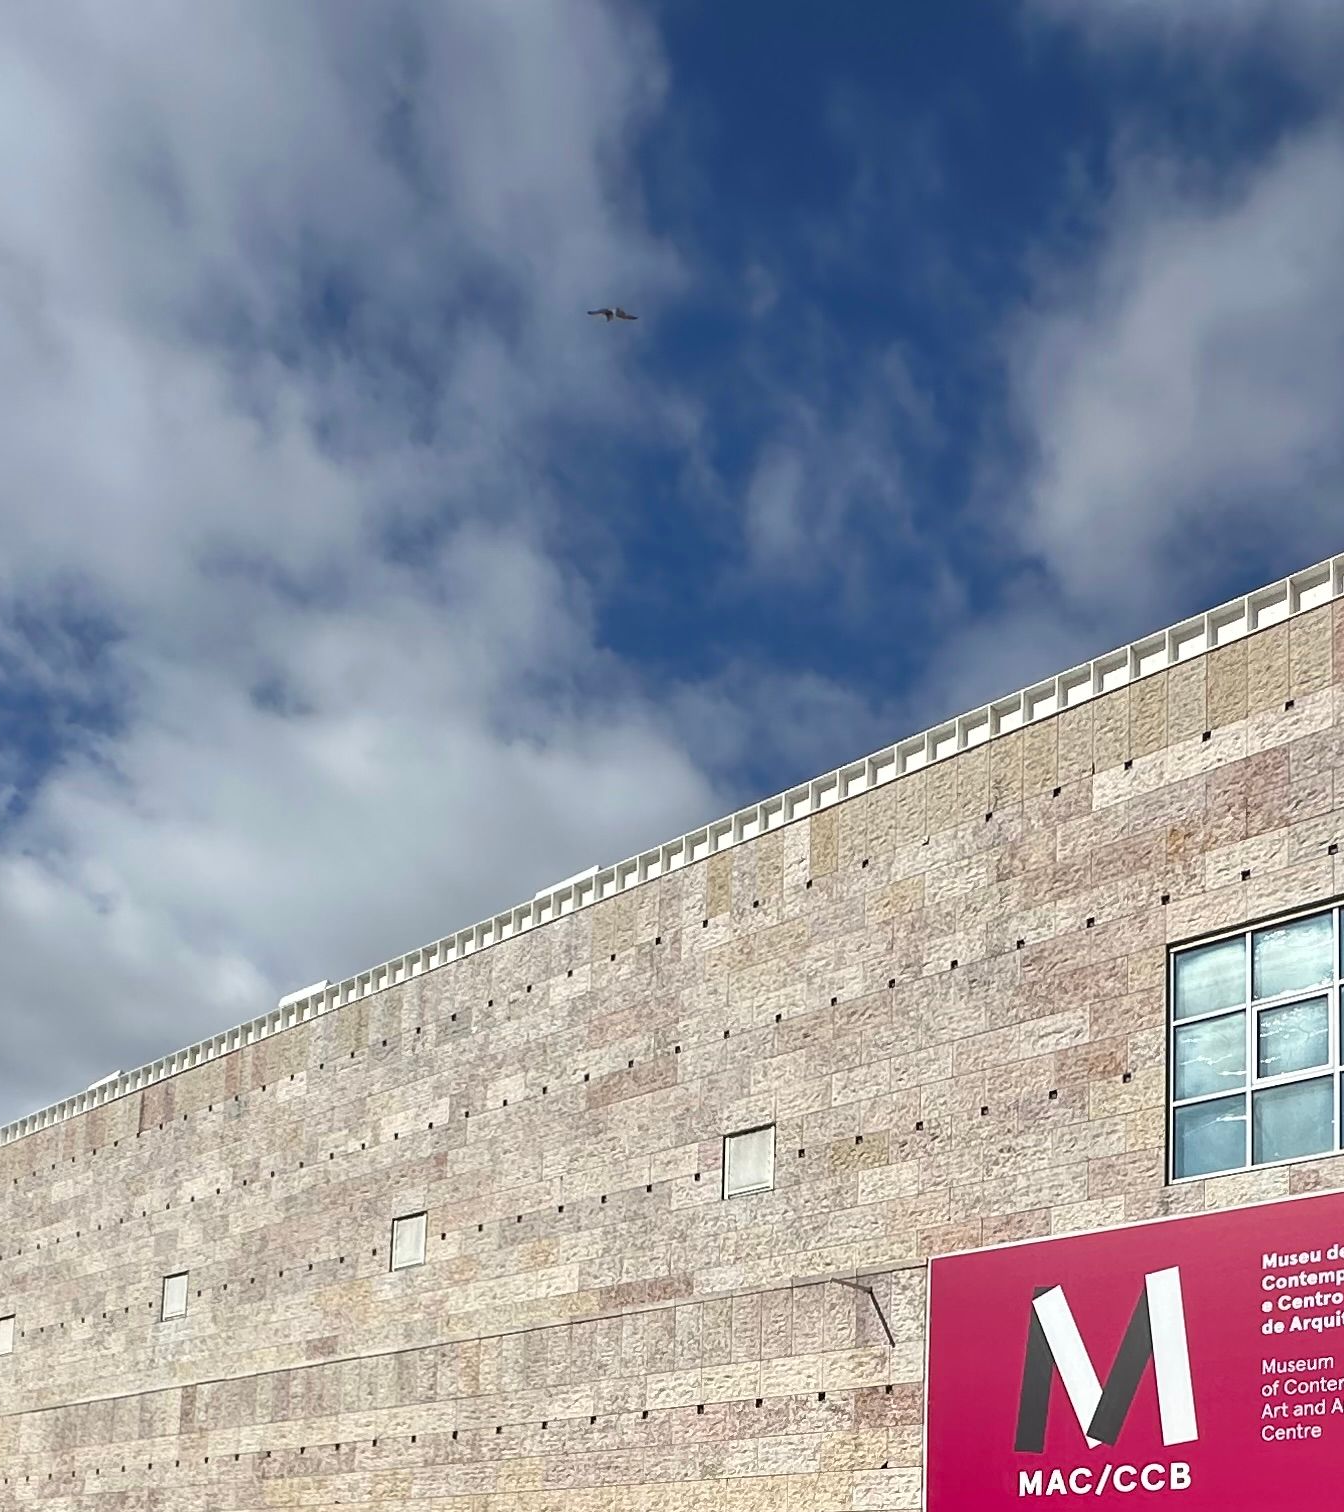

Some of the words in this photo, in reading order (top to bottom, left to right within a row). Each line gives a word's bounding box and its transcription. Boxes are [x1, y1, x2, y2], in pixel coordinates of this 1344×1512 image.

[1262, 1247, 1322, 1270] Museu
[1261, 1301, 1273, 1313] e
[1277, 1291, 1344, 1311] Centro
[1261, 1318, 1285, 1335] de
[1014, 1265, 1199, 1454] M
[1262, 1356, 1334, 1375] Museum
[1261, 1379, 1280, 1397] of
[1261, 1402, 1289, 1419] Art
[1292, 1398, 1326, 1417] and
[1261, 1423, 1322, 1442] Centre
[1018, 1462, 1192, 1497] MAC/CCB
